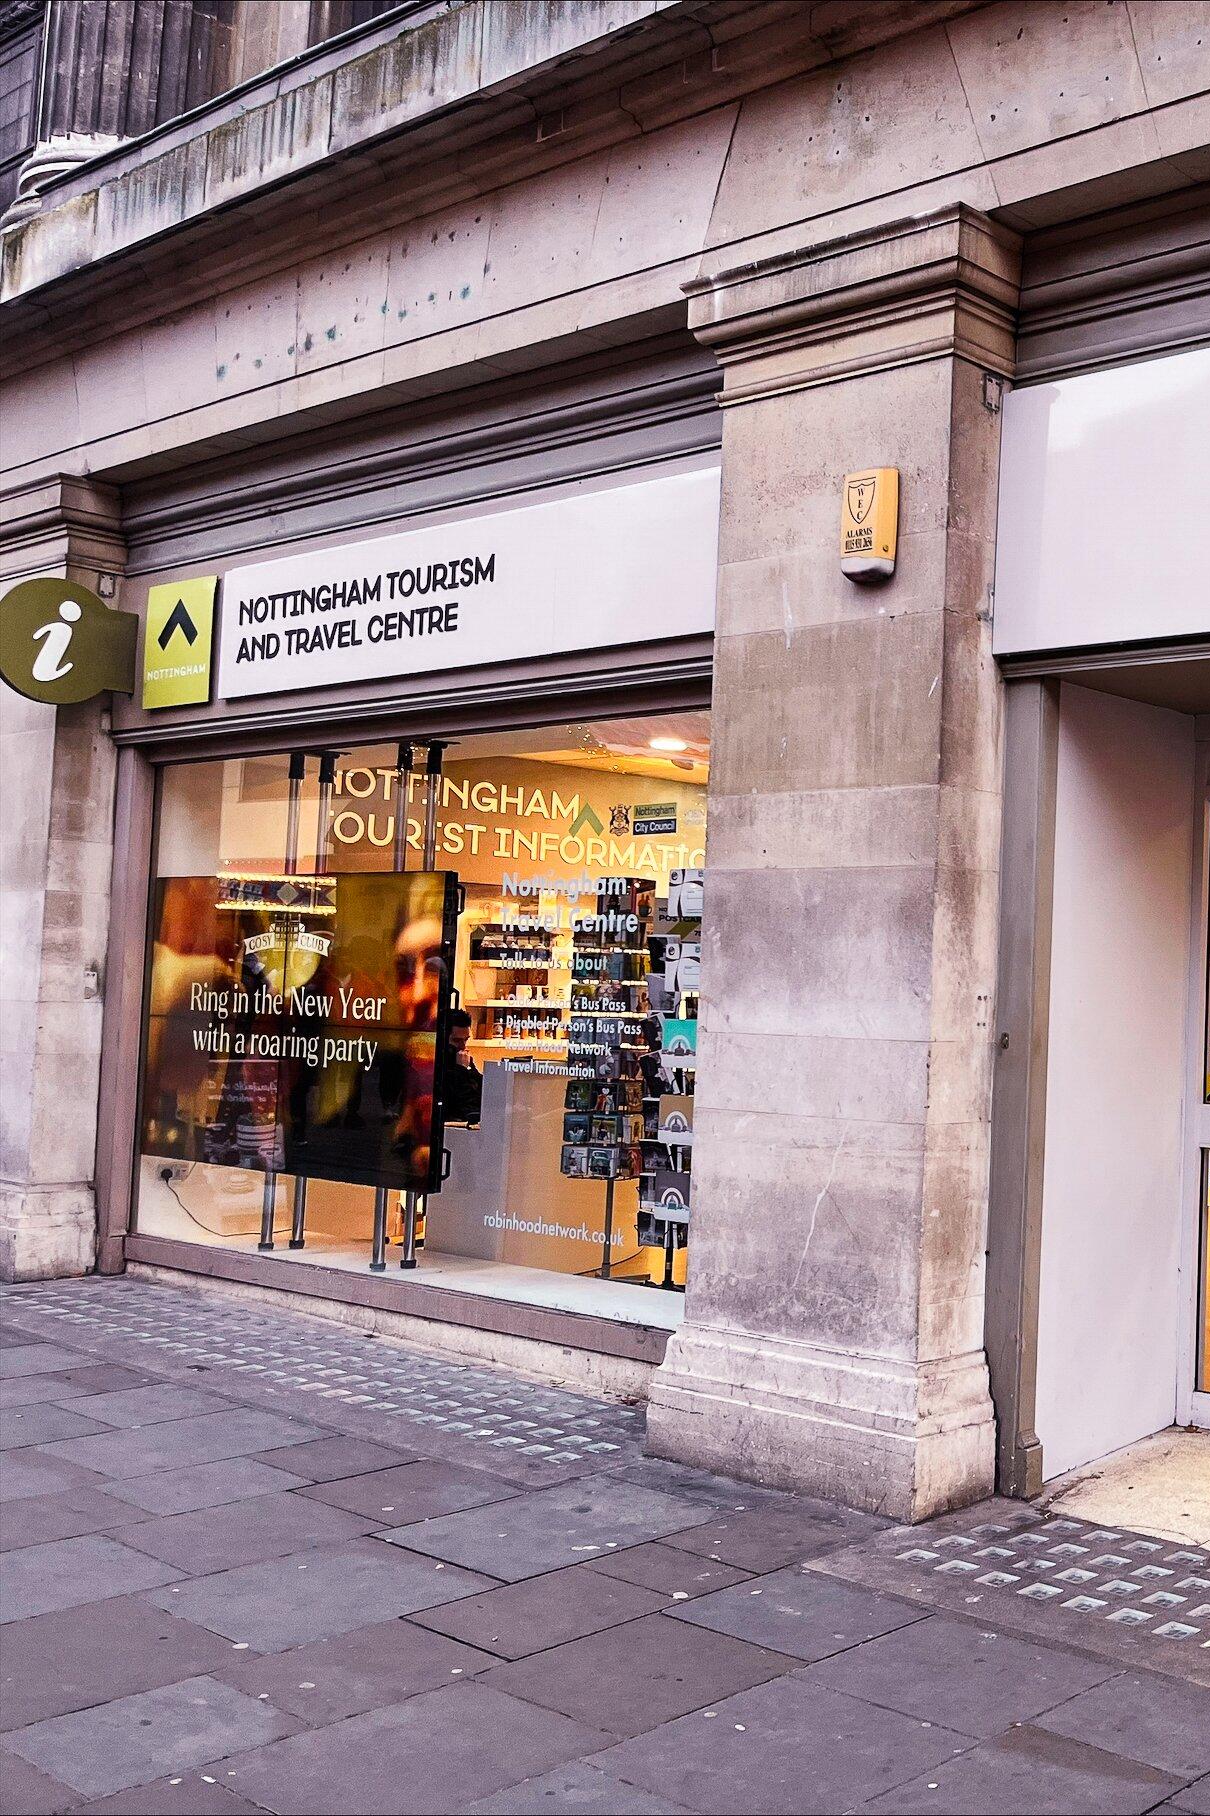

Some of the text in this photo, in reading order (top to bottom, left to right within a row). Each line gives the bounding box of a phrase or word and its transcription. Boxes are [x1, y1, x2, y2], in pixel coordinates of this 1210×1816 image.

[846, 527, 873, 539] ALARMS
[239, 553, 496, 626] NOTTINGHAM TOURISM
[236, 602, 459, 664] AND TRAVEL CENTRE
[147, 663, 206, 681] NOTTINGHAM
[635, 806, 676, 817] Nottingham
[635, 821, 675, 833] City Council
[502, 870, 627, 903] Nottingham
[500, 906, 639, 933] Travel Centre
[248, 935, 325, 952] COSY CLUB
[500, 951, 609, 971] Talk to us about
[190, 982, 387, 1021] Ring in the New Year
[581, 997, 598, 1010] Bus
[599, 998, 627, 1012] Pass
[506, 1015, 642, 1035] Disabled Person's Bus Pass
[192, 1023, 378, 1071] with a roaring party
[567, 1041, 612, 1058] Network
[504, 1059, 595, 1078] Travel Information
[483, 1210, 625, 1247] robinhoodnetwork.co.uk
